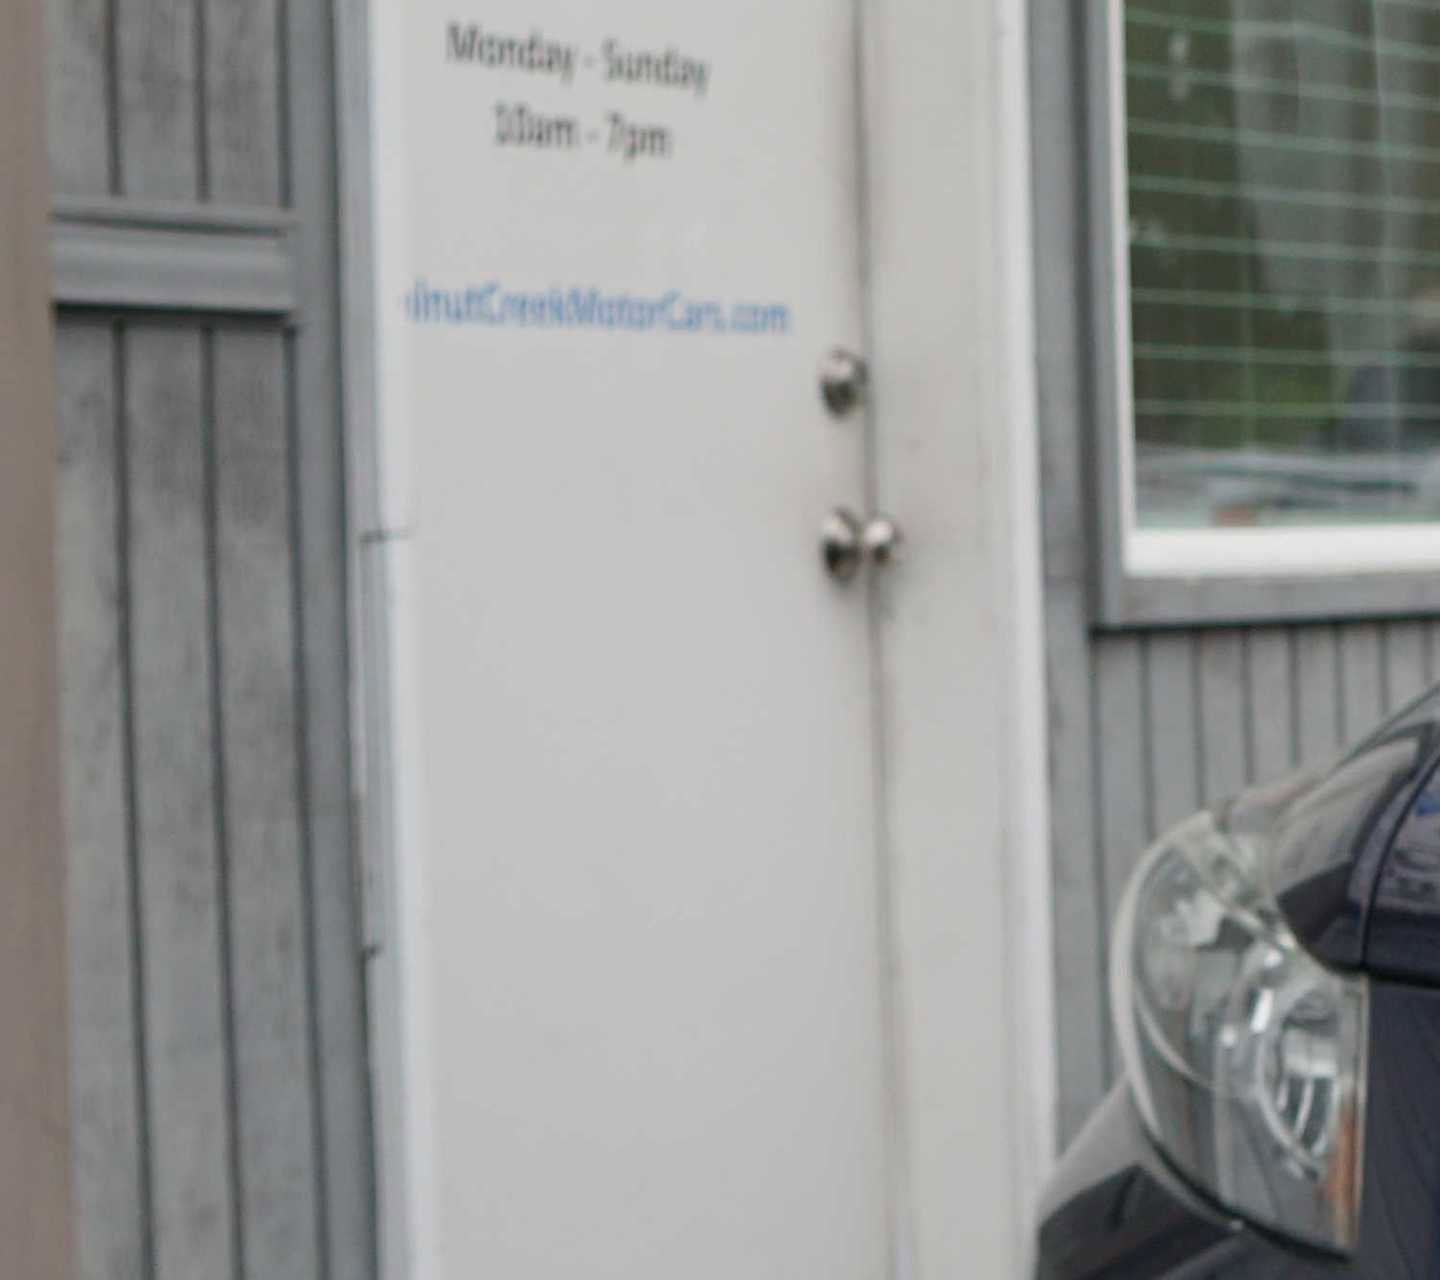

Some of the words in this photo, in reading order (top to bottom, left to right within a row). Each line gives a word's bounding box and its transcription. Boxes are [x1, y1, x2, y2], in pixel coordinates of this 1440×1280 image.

[446, 21, 575, 84] Monday
[601, 37, 710, 99] Sunday
[495, 101, 577, 148] 10am
[606, 111, 673, 165] 7pm
